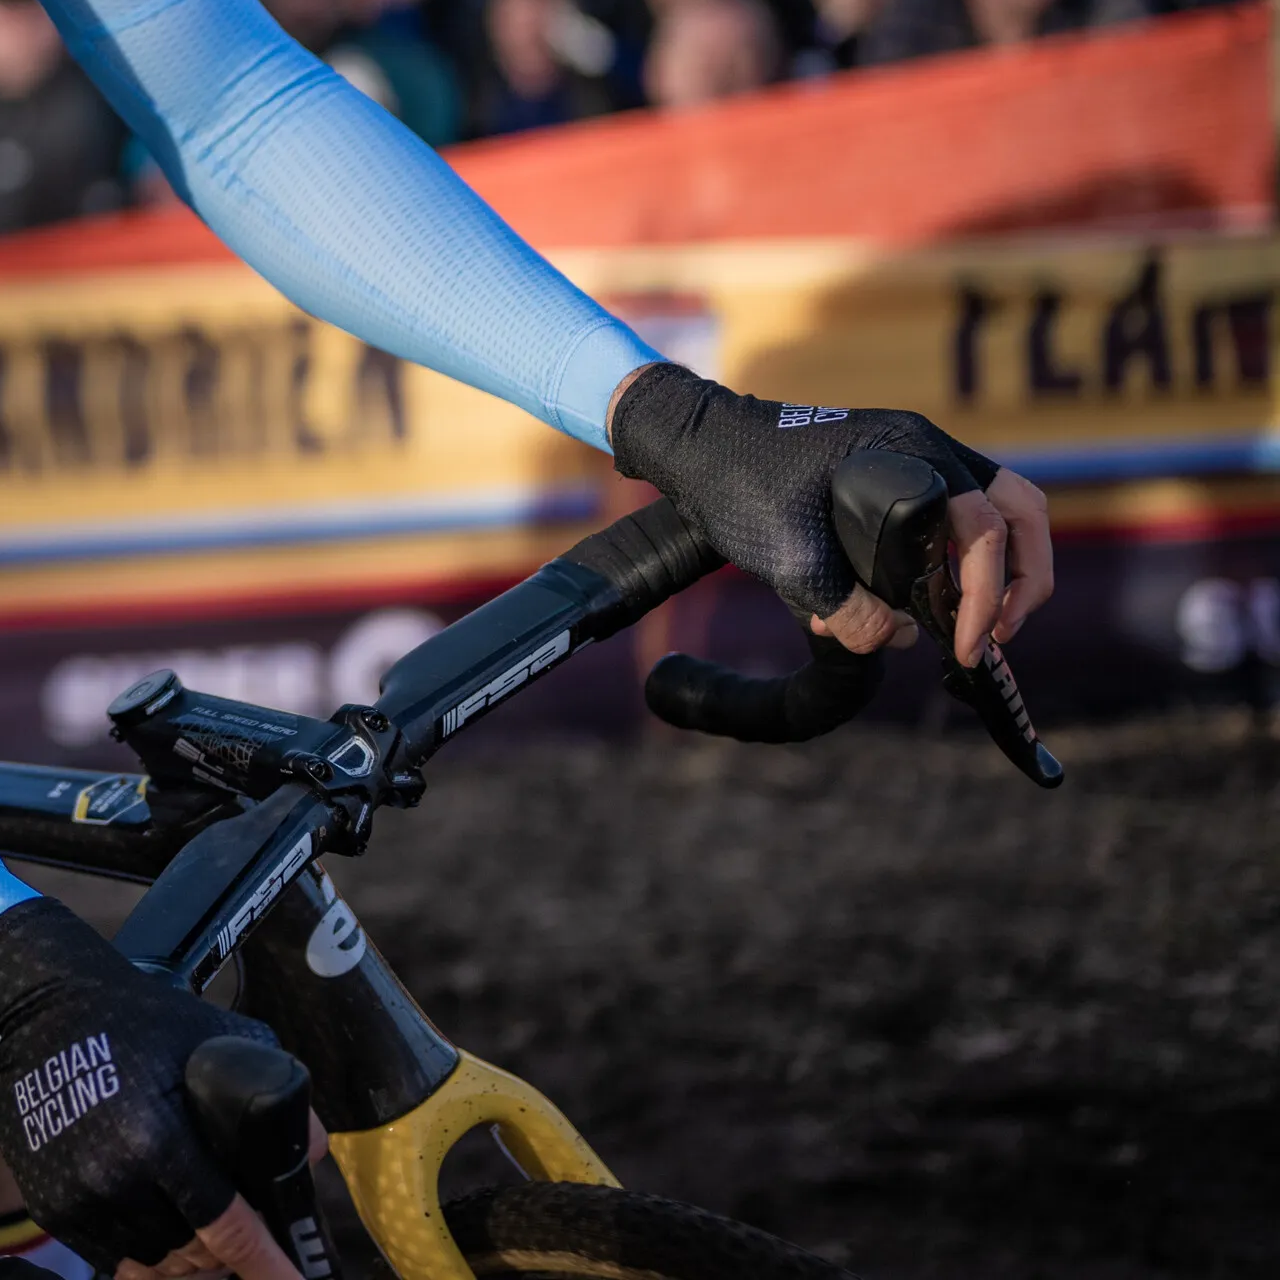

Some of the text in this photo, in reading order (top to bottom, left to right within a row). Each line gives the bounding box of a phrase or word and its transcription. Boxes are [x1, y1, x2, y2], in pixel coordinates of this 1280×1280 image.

[192, 705, 218, 718] FULL
[14, 1032, 112, 1116] BELGIAN
[22, 1063, 120, 1151] CYCLING
